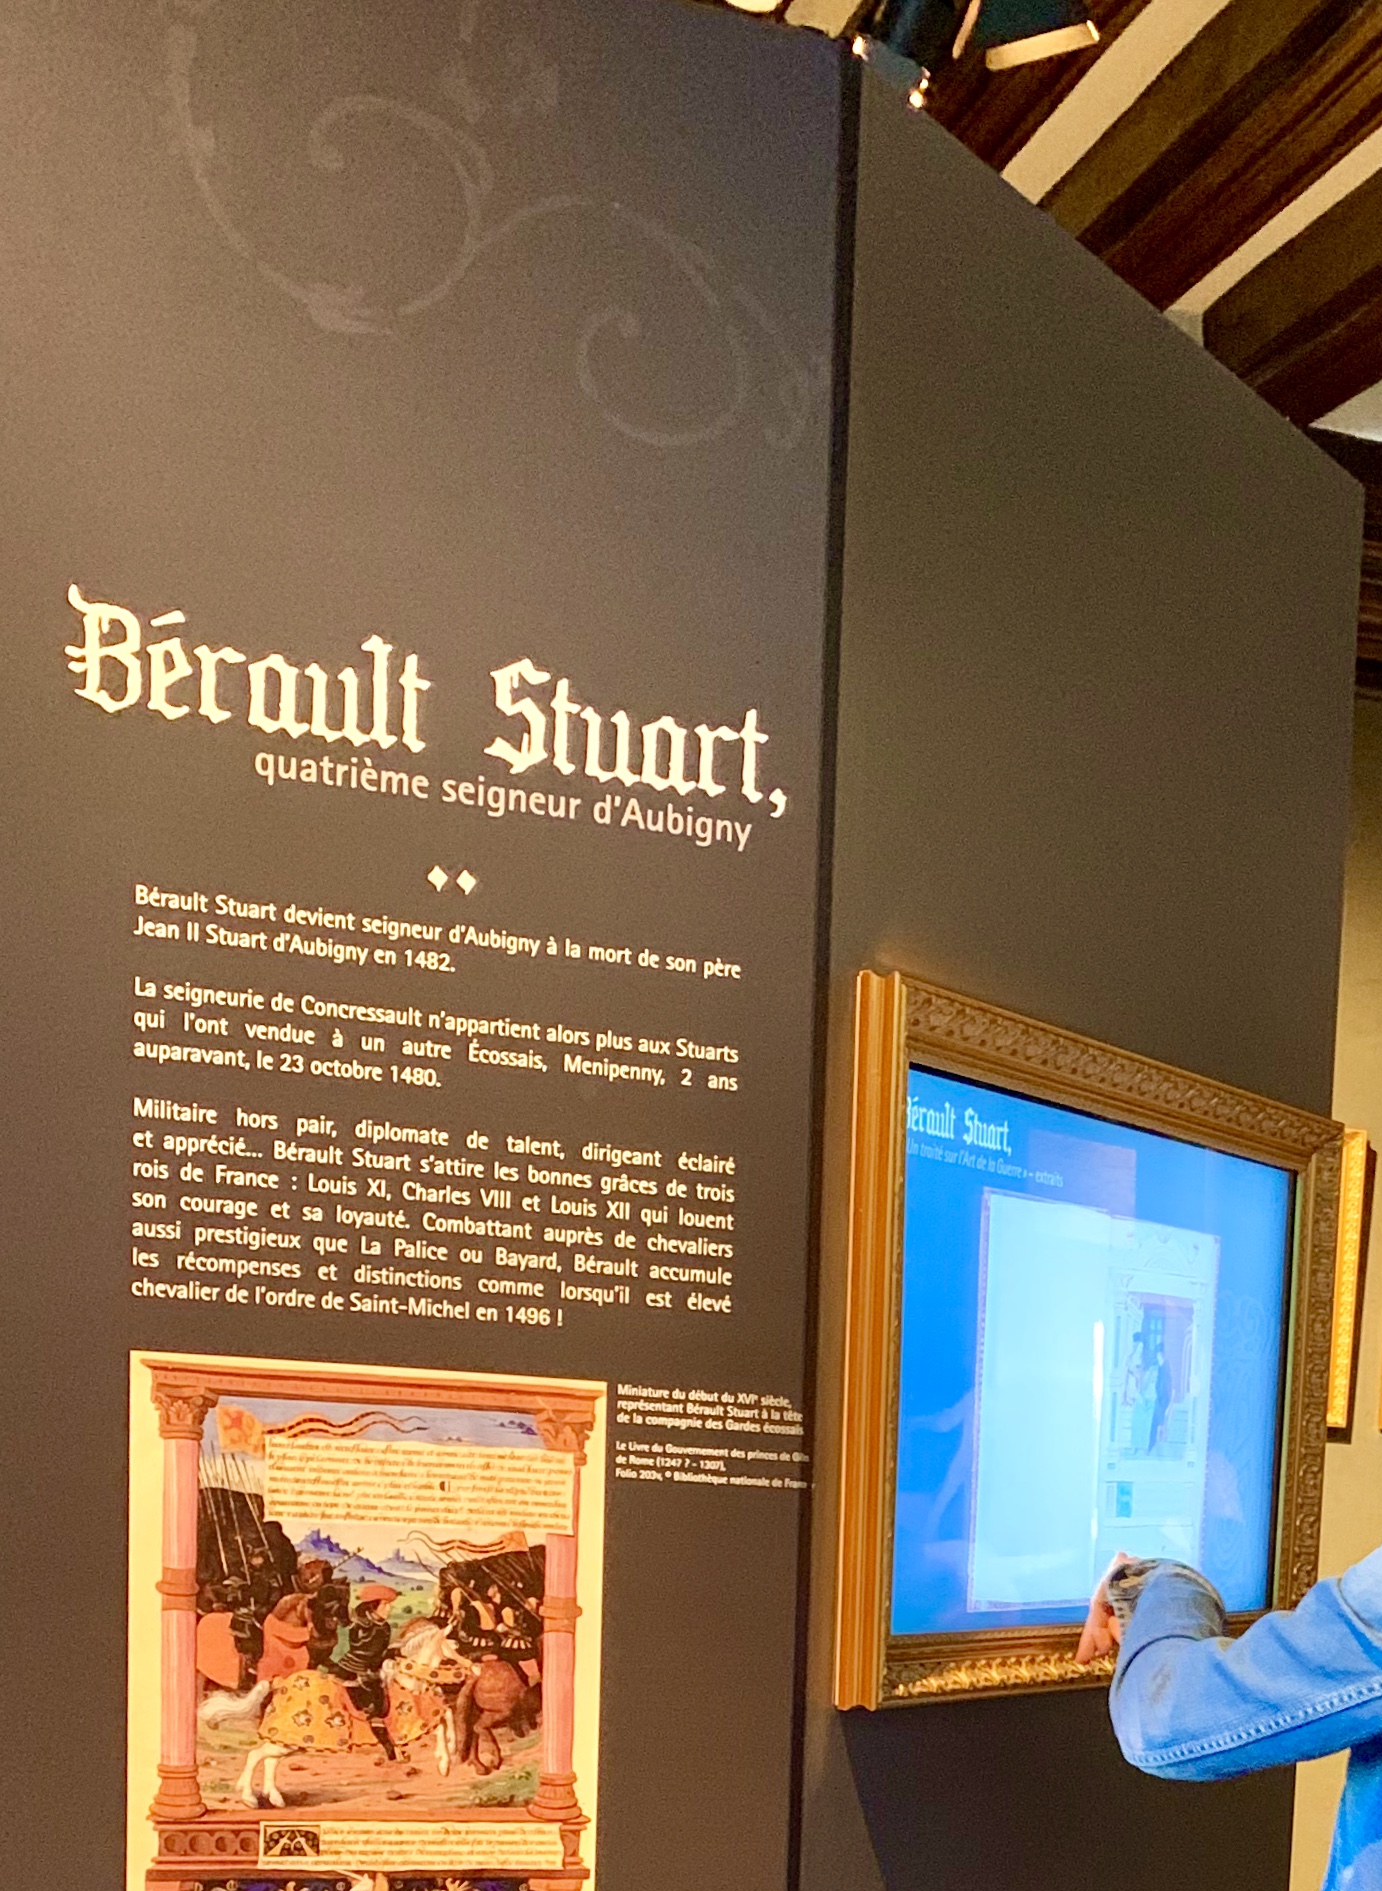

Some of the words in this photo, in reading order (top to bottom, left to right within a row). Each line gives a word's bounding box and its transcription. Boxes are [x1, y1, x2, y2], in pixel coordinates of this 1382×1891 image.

[65, 585, 431, 753] Bérault
[485, 658, 787, 818] Stuart,
[254, 747, 430, 800] quatrième
[441, 774, 583, 827] seigneur
[593, 793, 753, 853] d'Aubigny
[133, 915, 179, 940] Jean
[187, 921, 199, 942] II
[205, 923, 268, 950] Stuart
[272, 932, 369, 966] d'Aubigny
[373, 948, 396, 965] en
[404, 949, 455, 972] 1482.
[135, 883, 209, 913] Bérault
[215, 894, 277, 921] Stuart
[283, 903, 356, 931] devient
[361, 915, 443, 941] seigneur
[448, 924, 541, 957] d'Aubigny
[546, 935, 557, 955] à
[565, 937, 581, 958] la
[588, 946, 632, 965] mort
[637, 948, 660, 969] de
[665, 955, 696, 972] son
[703, 957, 741, 979] père
[134, 976, 156, 998] La
[163, 981, 264, 1010] seigneurie
[270, 992, 294, 1013] de
[301, 994, 423, 1027] Concressault
[428, 1010, 541, 1040] n'appartient
[546, 1023, 590, 1046] alors
[596, 1029, 633, 1052] plus
[638, 1038, 670, 1055] aux
[675, 1037, 739, 1063] Stuarts
[133, 1008, 165, 1032] qui
[184, 1011, 228, 1036] l'ont
[244, 1022, 315, 1045] vendue
[331, 1028, 343, 1048] à
[361, 1036, 385, 1052] un
[402, 1039, 452, 1059] autre
[468, 1038, 547, 1072] Écossais,
[564, 1053, 665, 1086] Menipenny,
[680, 1068, 692, 1086] 2
[707, 1074, 738, 1091] ans
[133, 1041, 250, 1070] auparavant,
[256, 1049, 274, 1070] le
[279, 1053, 304, 1073] 23
[310, 1059, 383, 1081] octobre
[390, 1065, 441, 1087] 1480.
[963, 1107, 1012, 1157] Stuart,
[131, 1277, 221, 1301] chevalier
[225, 1283, 249, 1304] de
[255, 1285, 316, 1308] l'ordre
[320, 1290, 344, 1310] de
[349, 1292, 470, 1319] Saint-Michel
[475, 1306, 498, 1321] en
[505, 1305, 551, 1326] 1496
[557, 1308, 563, 1326] !
[617, 1383, 670, 1399] Miniature
[671, 1388, 686, 1400] du
[688, 1389, 719, 1402] début
[720, 1391, 734, 1403] du
[760, 1395, 791, 1408] siècle,
[617, 1398, 684, 1414] représentant
[686, 1402, 724, 1416] Bérault
[726, 1405, 759, 1418] Stuart
[761, 1408, 768, 1419] à
[770, 1409, 780, 1420] la
[783, 1410, 802, 1421] tête
[616, 1411, 630, 1424] de
[632, 1412, 643, 1424] la
[645, 1415, 703, 1430] compagnie
[704, 1418, 723, 1430] des
[725, 1418, 761, 1432] Gardes
[762, 1421, 803, 1434] écossais
